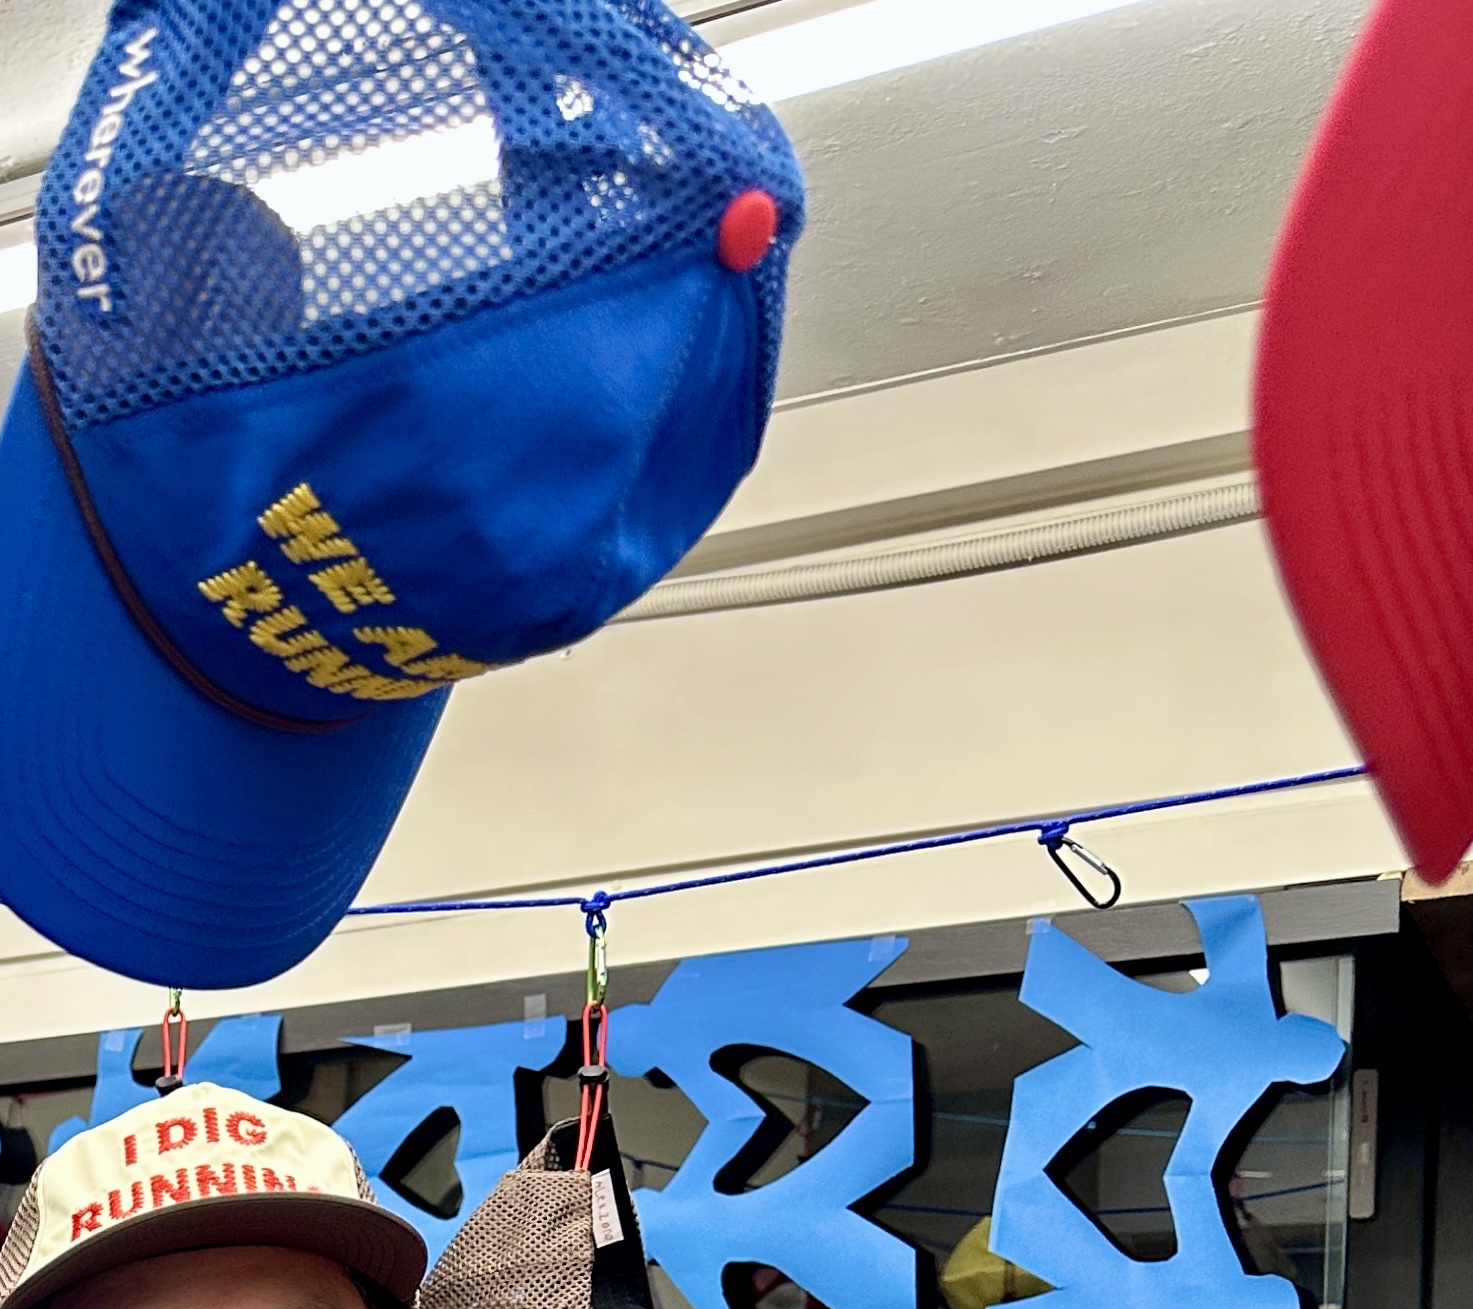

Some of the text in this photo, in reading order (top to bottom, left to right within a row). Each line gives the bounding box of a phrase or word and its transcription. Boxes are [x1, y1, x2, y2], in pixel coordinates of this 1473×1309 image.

[69, 27, 159, 313] wherever
[257, 485, 396, 614] WE
[124, 1106, 268, 1168] I DIG
[70, 1161, 324, 1243] RUNNIN
